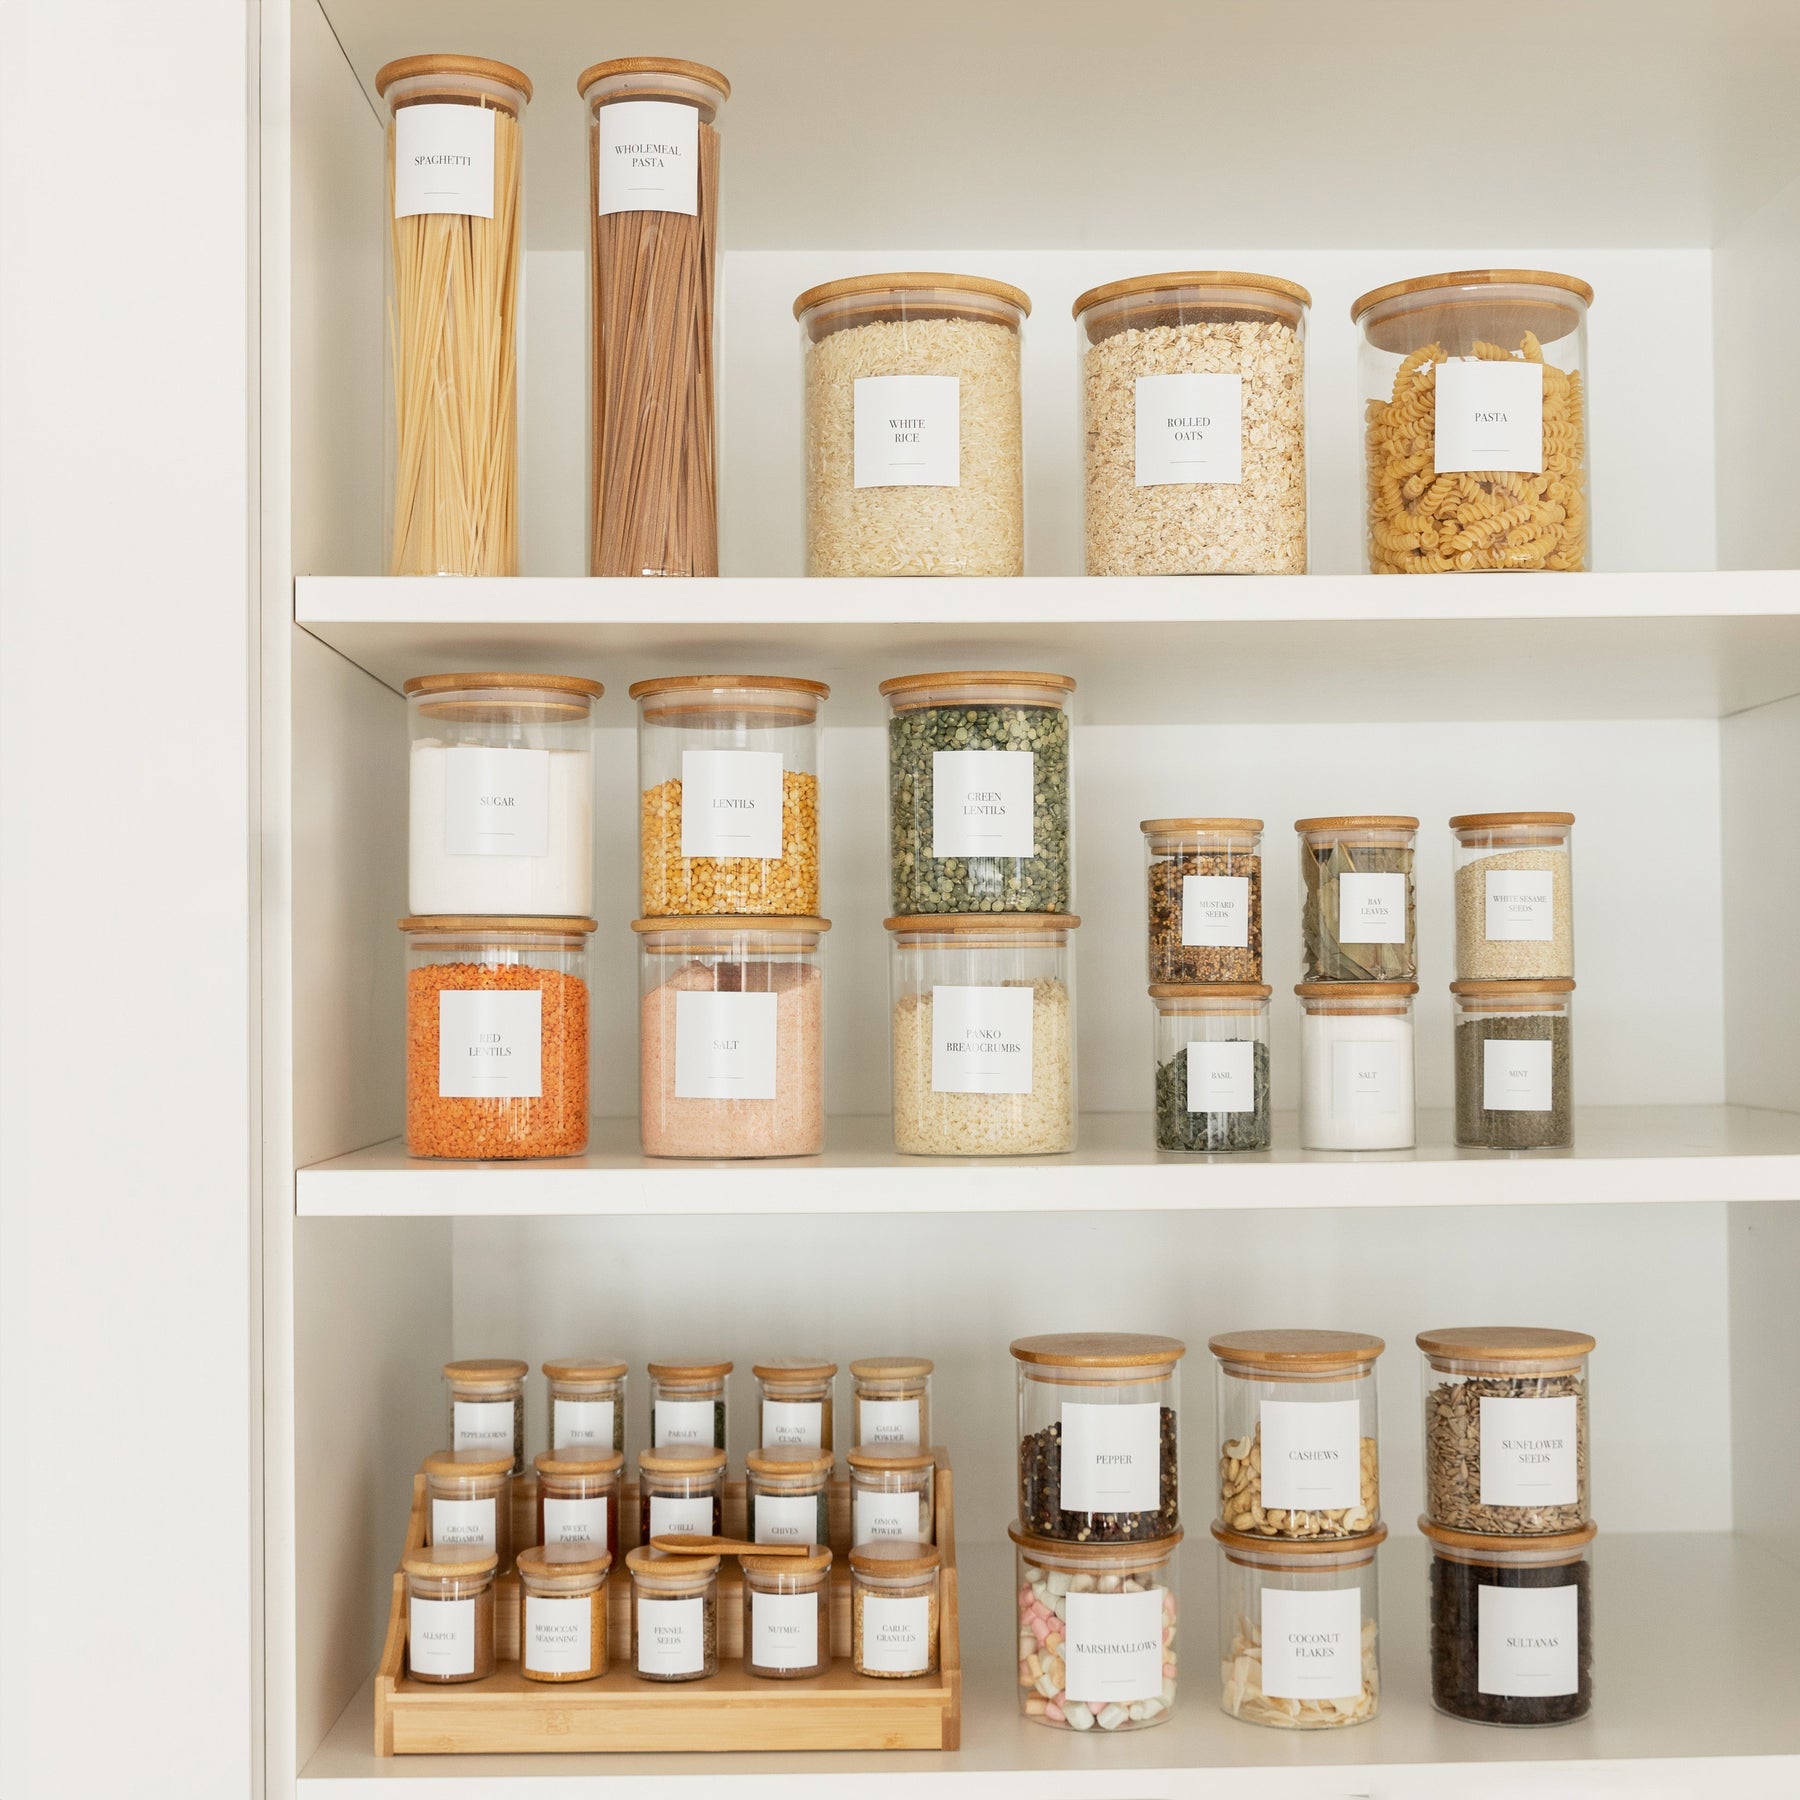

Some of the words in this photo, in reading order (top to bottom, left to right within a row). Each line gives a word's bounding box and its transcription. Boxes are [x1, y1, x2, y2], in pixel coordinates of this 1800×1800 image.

[615, 144, 682, 156] WHOLEMEAL
[414, 155, 471, 166] SPAGHETTI
[632, 157, 665, 168] PASTA
[1167, 417, 1211, 428] ROLLED
[1474, 412, 1508, 423] PASTA
[889, 419, 925, 429] WHITE
[894, 433, 920, 443] RICE
[1174, 431, 1204, 441] OATS
[480, 796, 515, 807] SUGAR
[967, 792, 1002, 802] GREEN
[712, 799, 755, 809] LENTILS
[963, 805, 1006, 815] LENTILS
[1493, 895, 1518, 903] WHITE
[1519, 895, 1547, 903] SESAME
[1199, 901, 1234, 909] MUSTARD
[1205, 910, 1229, 918] SEEDS
[1361, 907, 1389, 915] LEAVES
[479, 1033, 501, 1043] RED
[966, 1029, 1001, 1039] PANKO
[713, 1040, 739, 1050] SALT
[946, 1042, 1021, 1053] BREADCRUMBS
[468, 1046, 511, 1057] LENTILS
[1501, 1439, 1563, 1450] SUNFLOWER
[1096, 1455, 1132, 1465] PEPPER
[1288, 1450, 1339, 1461] CASHEWS
[1518, 1453, 1550, 1463] SEEDS
[668, 1523, 694, 1531] CHILLI
[871, 1527, 902, 1535] POWDER
[442, 1535, 484, 1543] CARDAMOM
[560, 1534, 590, 1542] PAPRIKA
[535, 1624, 578, 1633] MOROCCAN
[654, 1626, 683, 1634] FENNEL
[768, 1625, 800, 1634] NUTMEG
[882, 1624, 910, 1633] GARLIC
[422, 1632, 457, 1640] ALLSPICE
[535, 1635, 577, 1643] SEASONING
[657, 1636, 681, 1645] SEEDS
[876, 1633, 916, 1642] GRANULES
[1288, 1633, 1339, 1643] COCONUT
[1075, 1640, 1157, 1653] MARSHMALLOWS
[1506, 1637, 1558, 1647] SULTANAS
[1295, 1646, 1335, 1657] FLAKES
